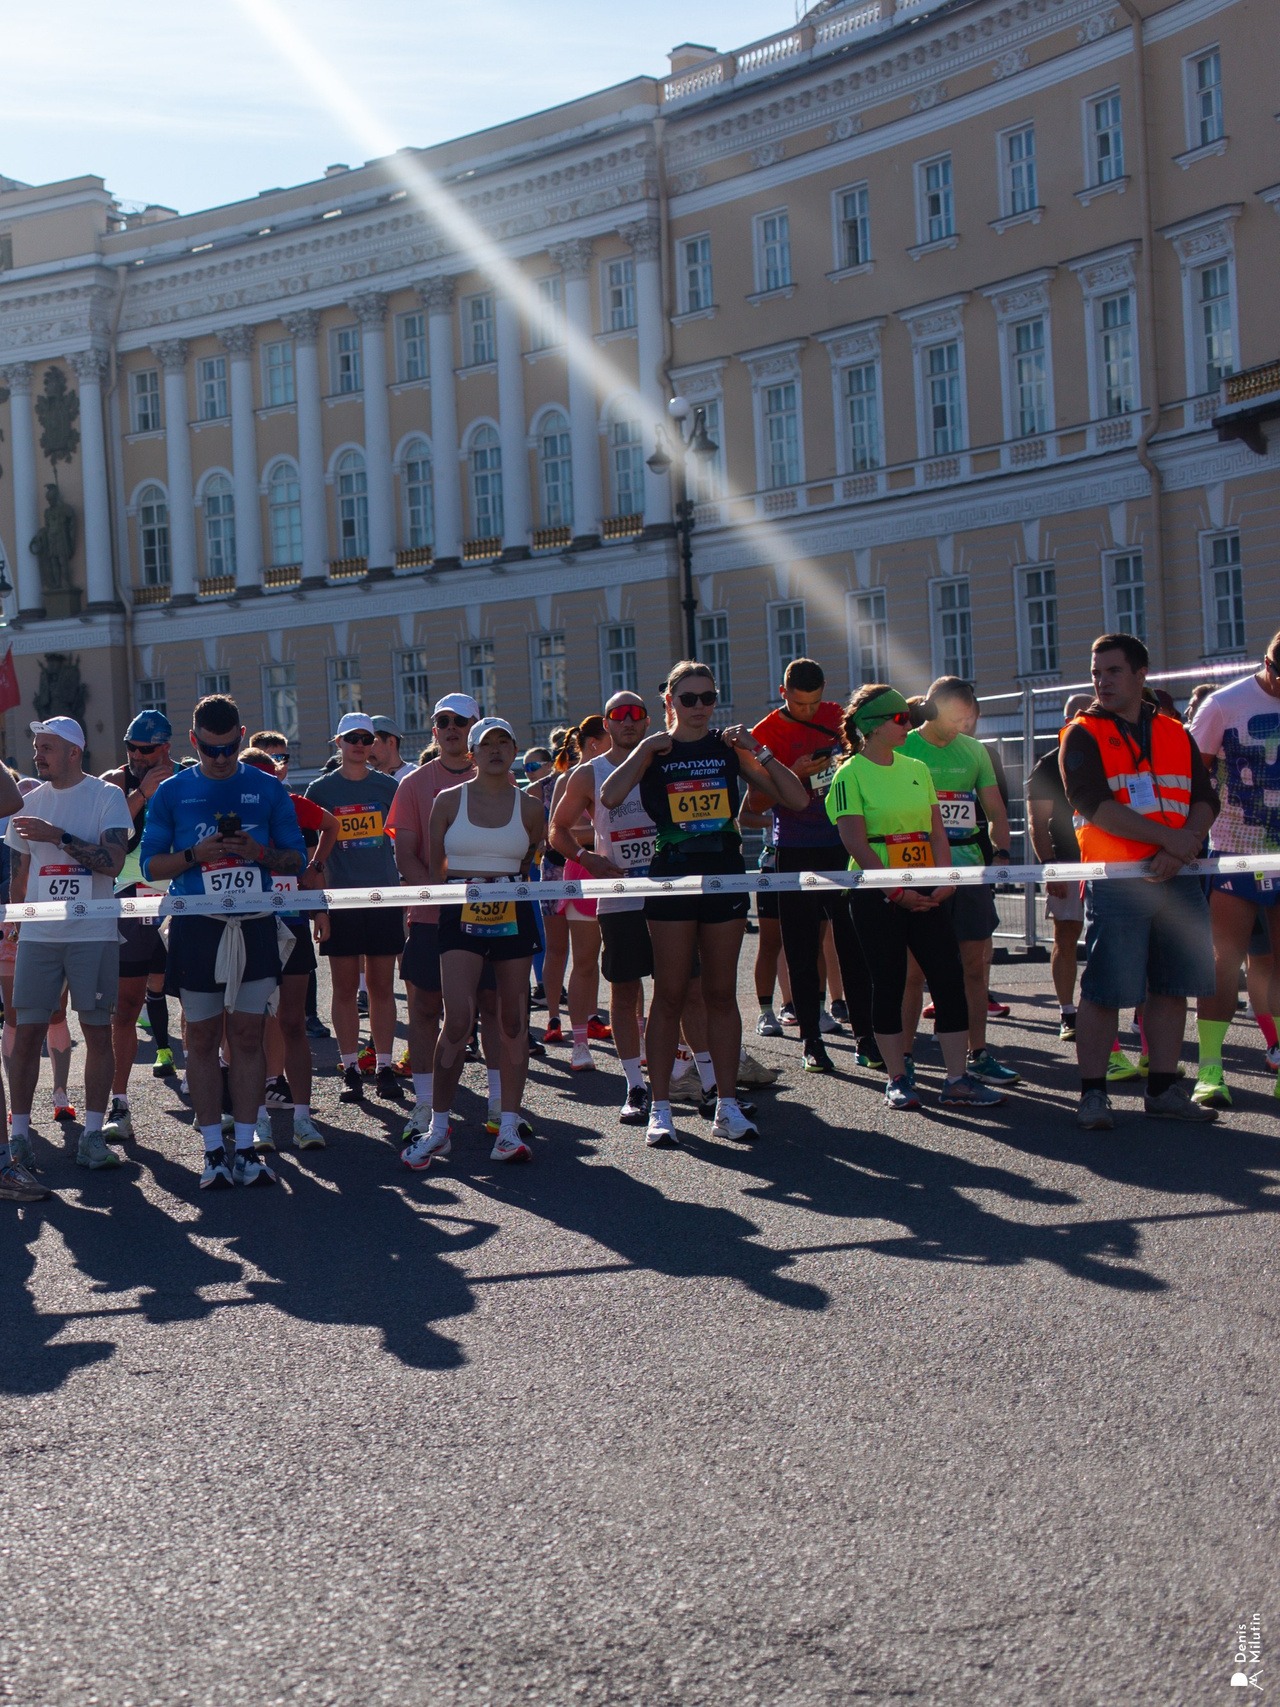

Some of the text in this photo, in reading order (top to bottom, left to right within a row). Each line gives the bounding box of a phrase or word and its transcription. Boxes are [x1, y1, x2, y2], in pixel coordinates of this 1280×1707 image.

[661, 759, 726, 773] УРАЛХИМ
[690, 768, 720, 776] FACTORY
[678, 794, 720, 812] 6137
[941, 804, 970, 820] 372
[342, 816, 376, 832] 5041
[342, 840, 348, 848] E
[620, 840, 656, 860] 5981
[902, 846, 926, 862] 631
[49, 880, 80, 895] 675
[210, 871, 254, 892] 5769
[1264, 879, 1270, 889] E
[470, 902, 509, 916] 4587
[145, 916, 150, 924] E
[466, 924, 472, 934] E
